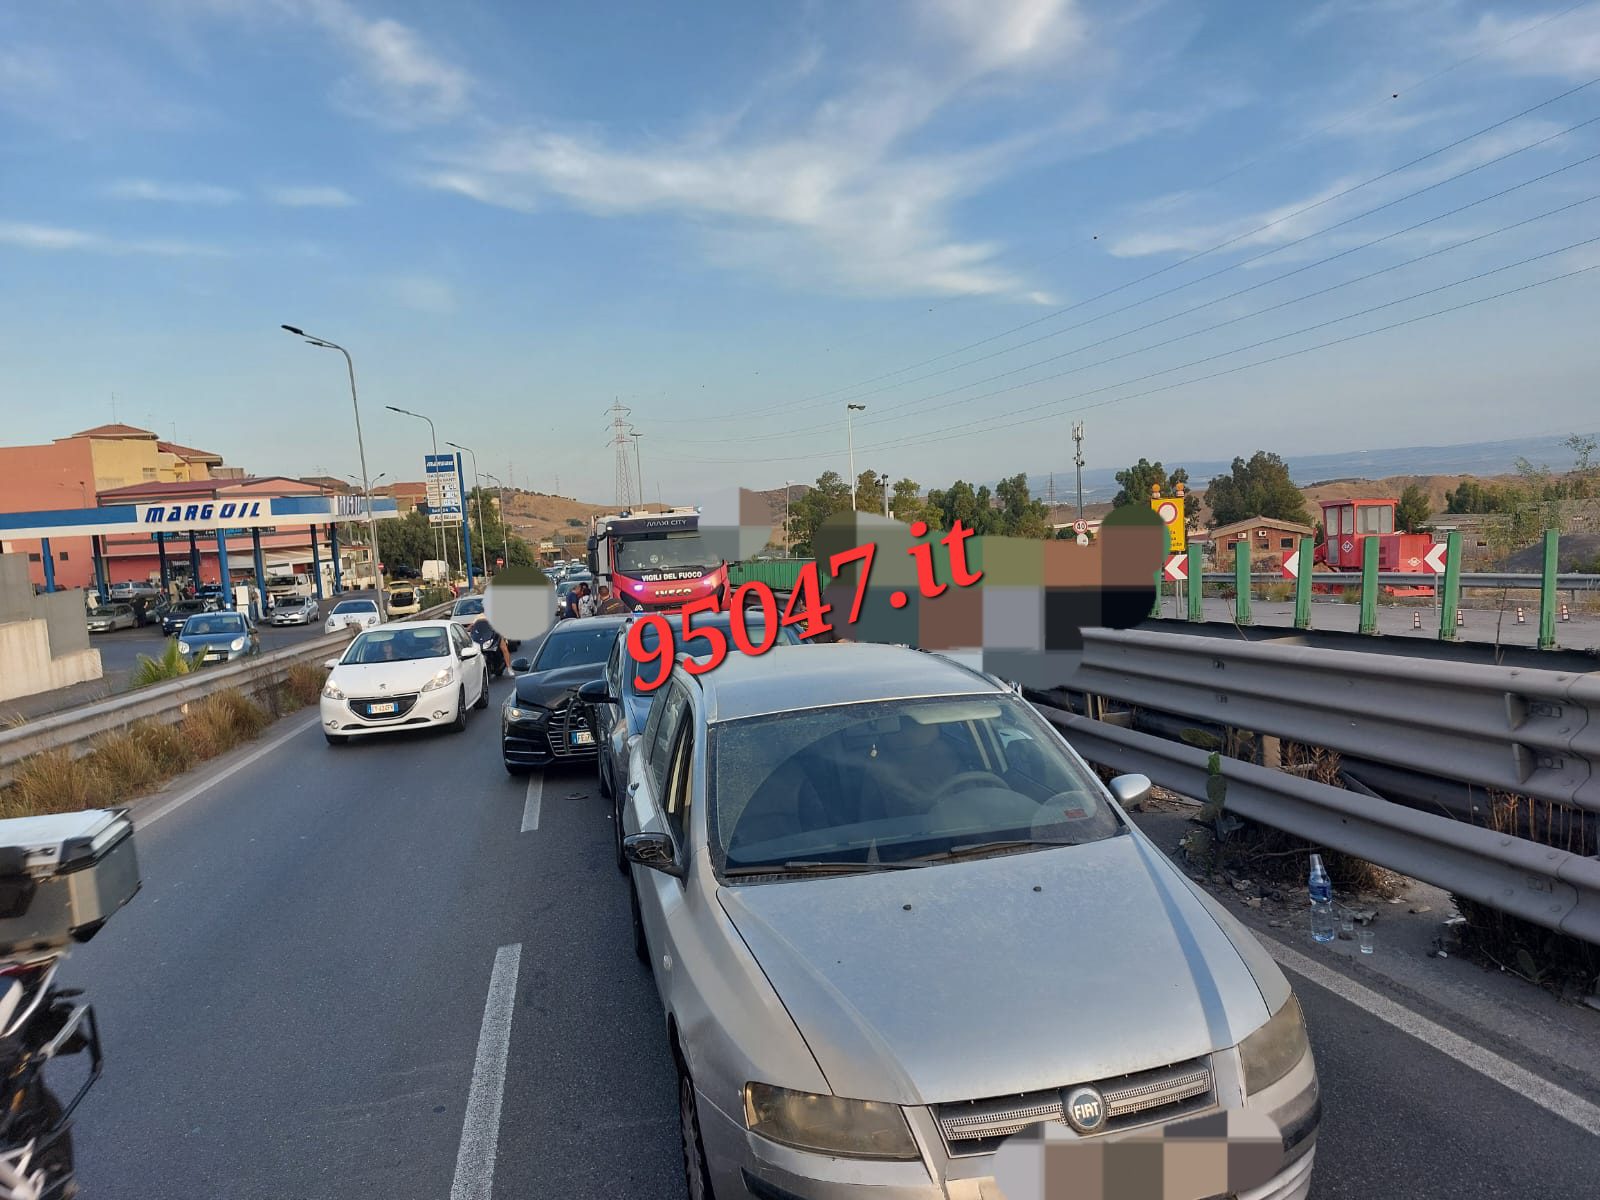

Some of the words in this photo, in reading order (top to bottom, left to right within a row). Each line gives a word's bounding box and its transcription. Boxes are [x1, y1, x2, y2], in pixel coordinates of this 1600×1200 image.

[1076, 522, 1085, 530] 40
[678, 571, 703, 579] FUOCO
[655, 588, 691, 597] IVECO
[1074, 1102, 1098, 1120] FIAT
